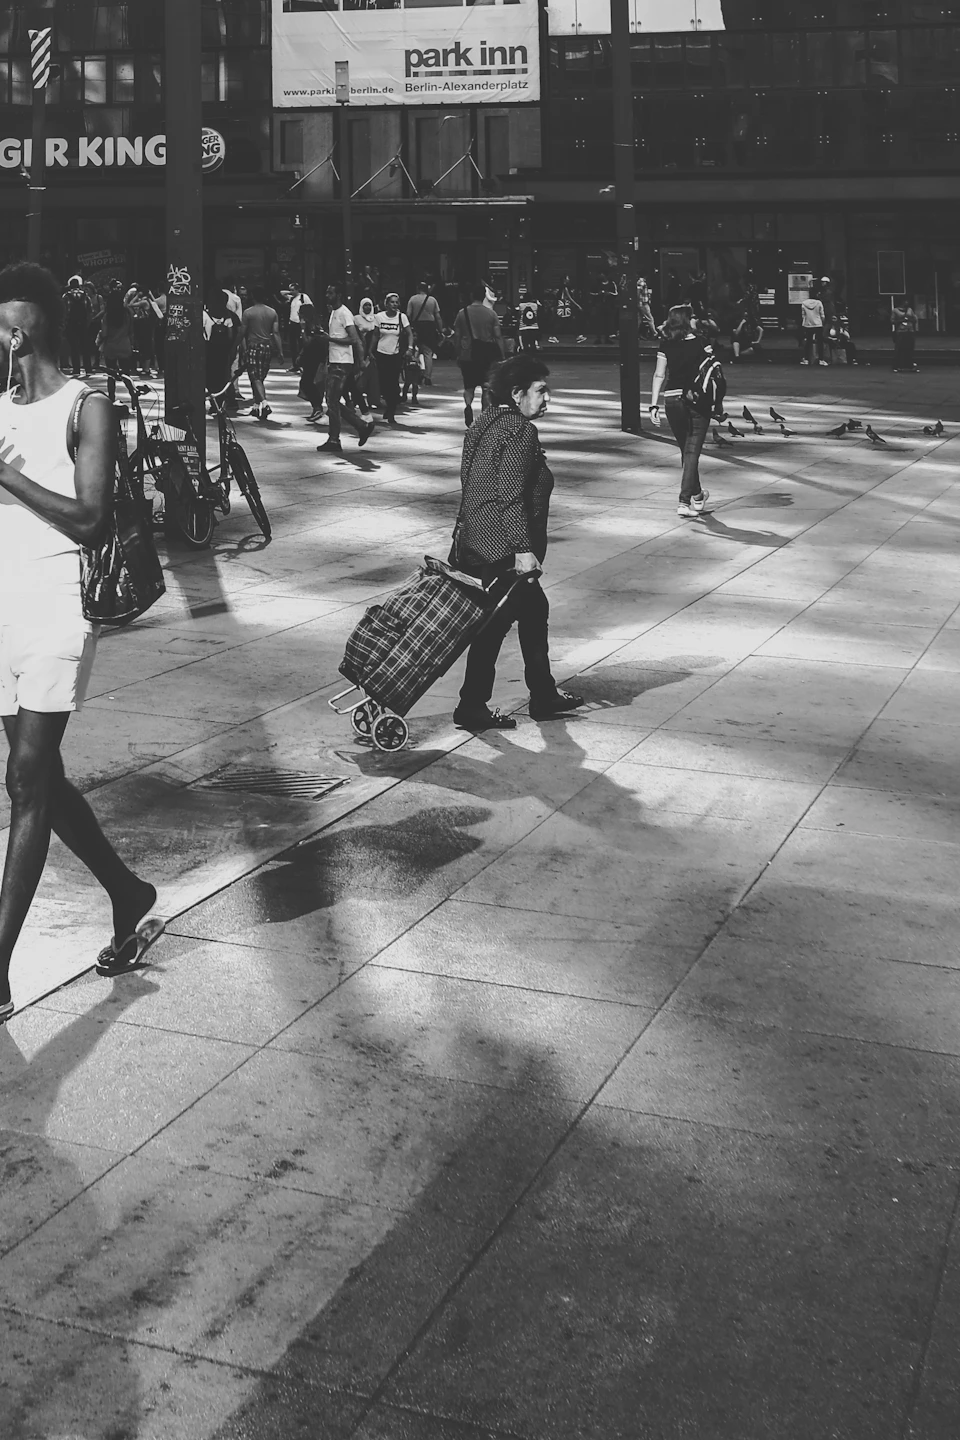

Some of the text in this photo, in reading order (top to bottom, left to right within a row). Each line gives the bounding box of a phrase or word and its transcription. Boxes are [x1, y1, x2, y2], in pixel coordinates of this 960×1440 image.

[405, 40, 528, 78] park inn
[405, 80, 529, 93] Berlin-Alexanderplatz
[78, 134, 167, 167] KING
[202, 135, 219, 145] GER
